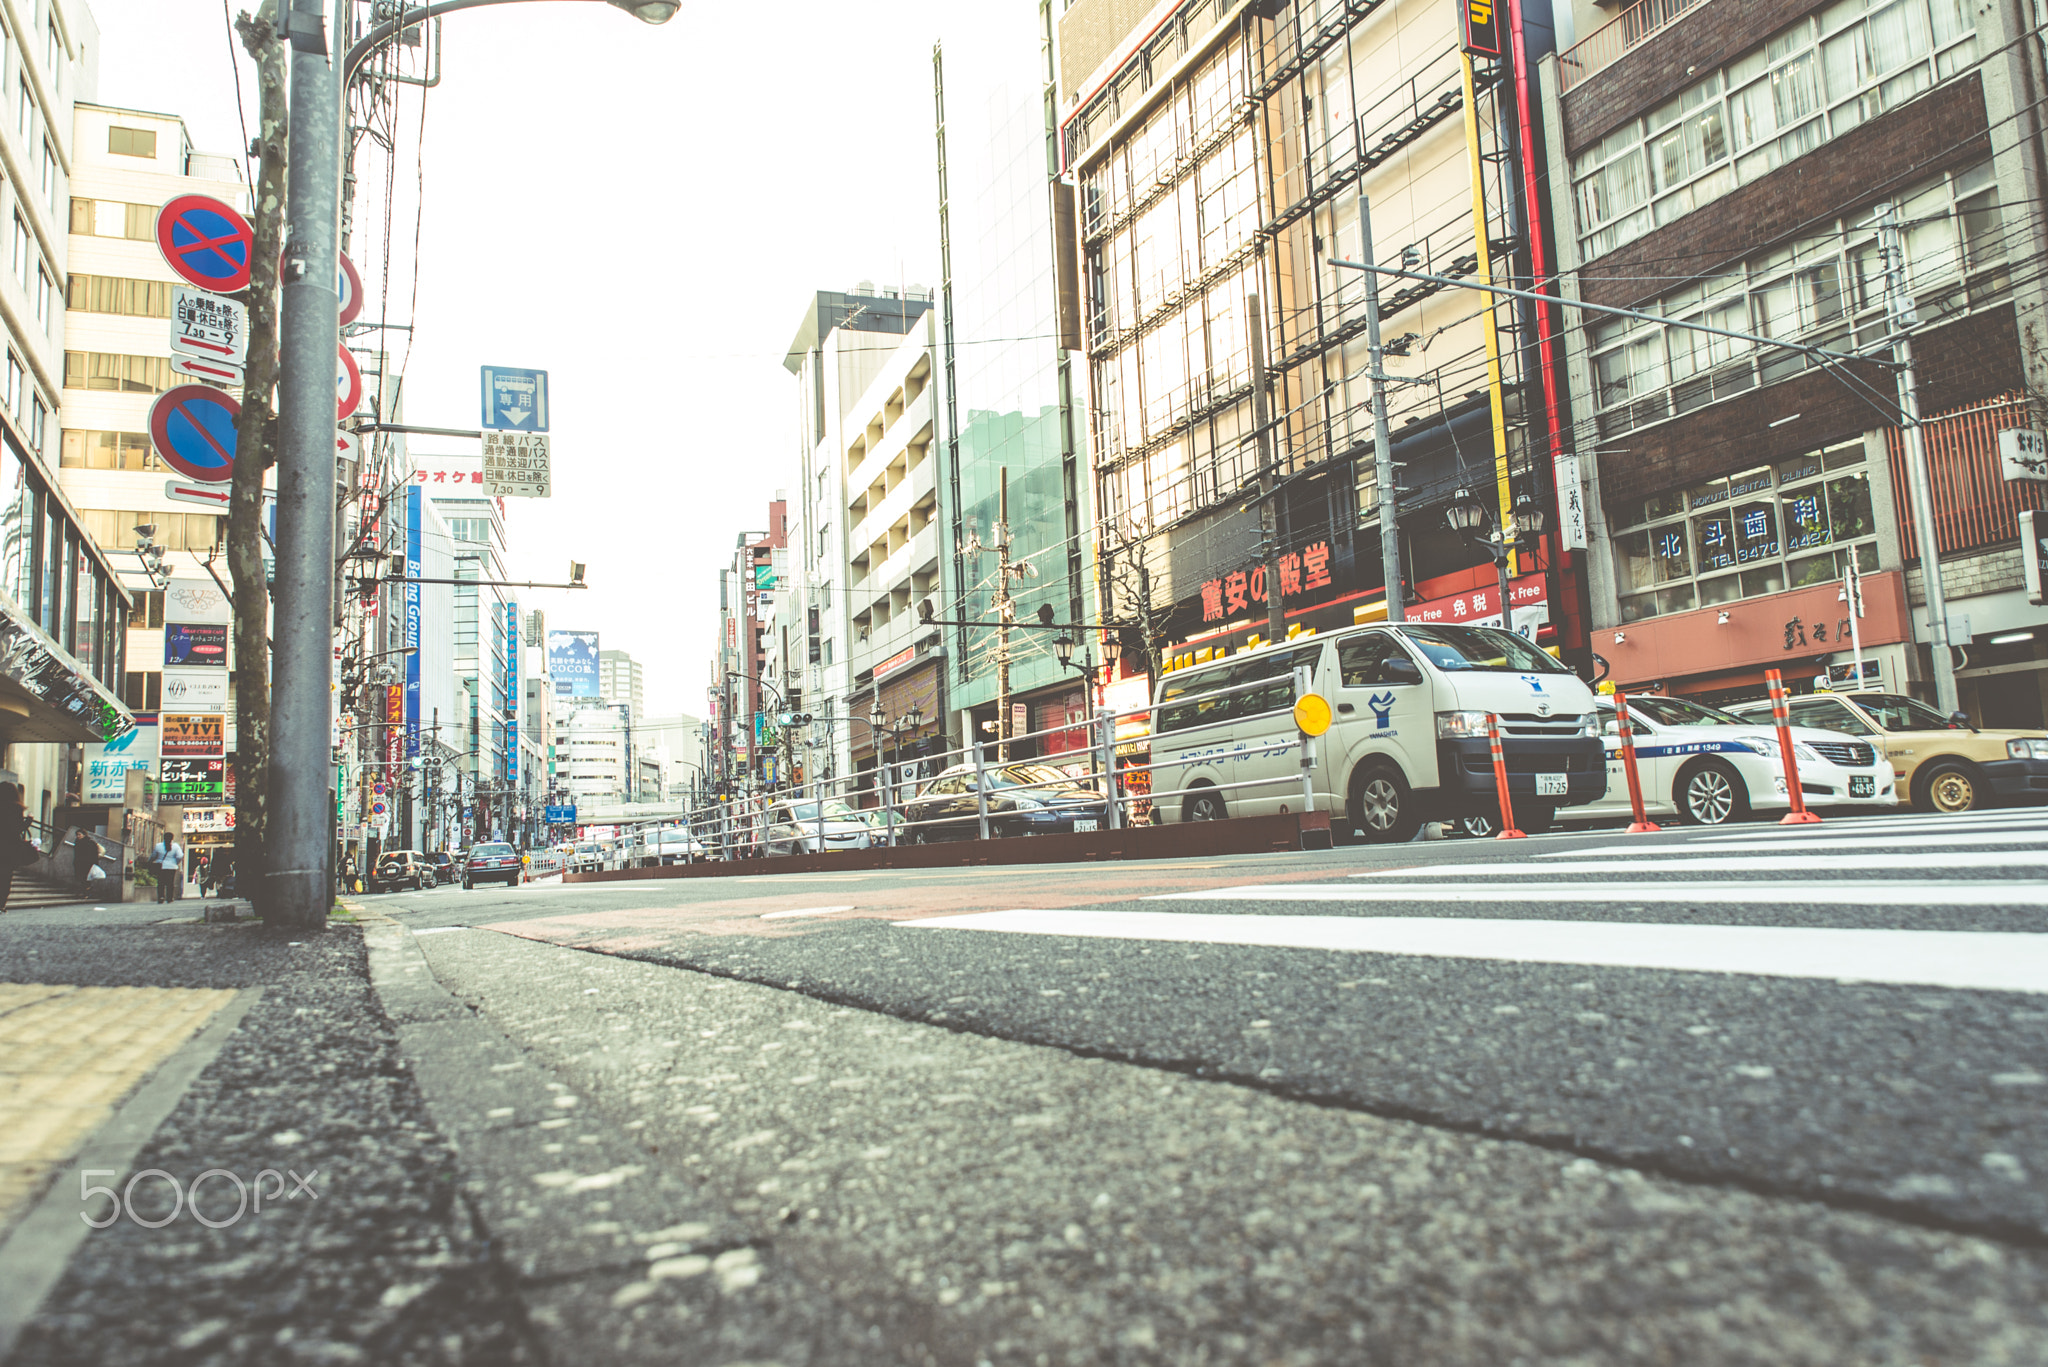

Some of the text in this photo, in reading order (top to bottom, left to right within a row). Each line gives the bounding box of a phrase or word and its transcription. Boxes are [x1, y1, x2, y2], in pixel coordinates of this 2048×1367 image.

[178, 293, 239, 320] 人の乗降を除く
[182, 321, 205, 338] 7.30
[224, 331, 234, 345] 9
[499, 393, 532, 407] 専用
[487, 434, 545, 447] 路線バス
[485, 445, 548, 458] 通学通園バス
[485, 456, 548, 469] 通勤送迎バス
[1731, 476, 1773, 497] DENTAL
[1781, 464, 1816, 483] CLINIC
[490, 483, 513, 495] 7.30
[536, 485, 545, 496] 9
[1660, 496, 1820, 559] 北斗歯科
[1711, 529, 1831, 568] TEL 3470 4427
[1518, 585, 1540, 599] Free
[1453, 593, 1487, 617] 免税
[1406, 608, 1442, 623] Tax Free
[180, 723, 220, 735] VIVI
[1369, 730, 1399, 739] YAMASHITA
[1702, 743, 1721, 752] 1349
[162, 760, 191, 771] ダーツ
[209, 761, 222, 770] 3F
[161, 771, 207, 782] ビリヤード
[184, 783, 216, 792] ゴルフ
